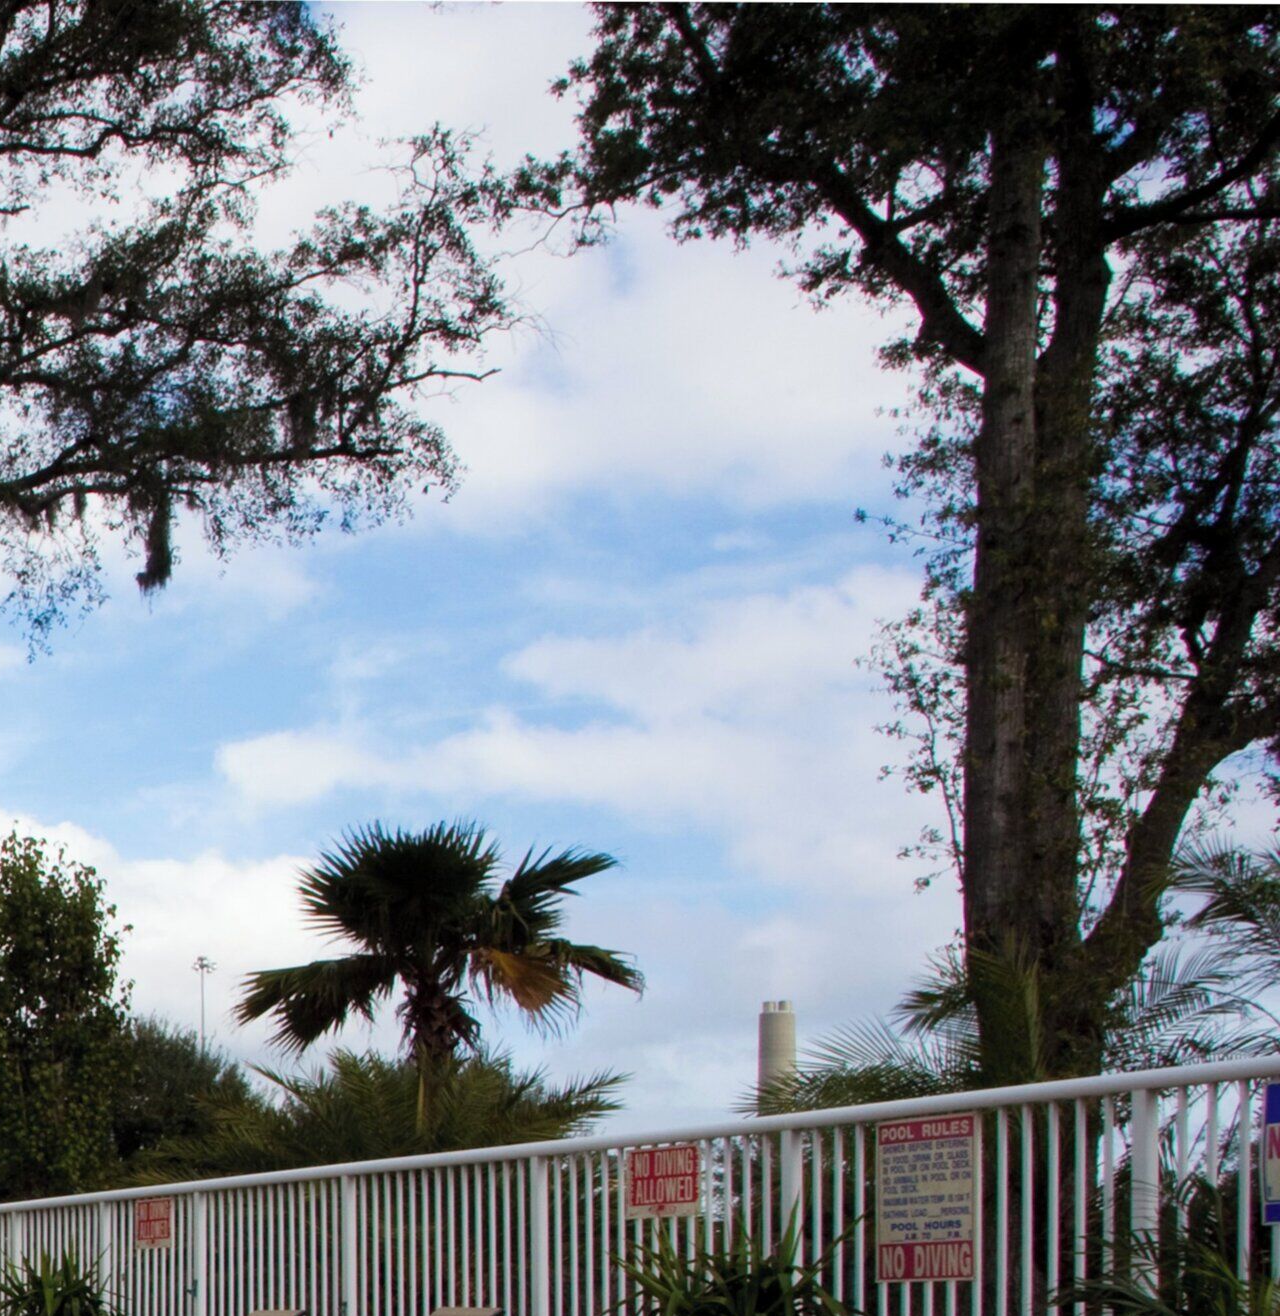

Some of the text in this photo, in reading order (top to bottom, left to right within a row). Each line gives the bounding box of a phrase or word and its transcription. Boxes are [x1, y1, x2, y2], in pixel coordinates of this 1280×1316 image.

[881, 1119, 970, 1142] POOL RULES
[635, 1148, 694, 1178] NO DIVING
[636, 1176, 693, 1205] ALLOWED
[891, 1220, 963, 1231] POOL HOURS
[882, 1242, 972, 1279] NO DIVING
